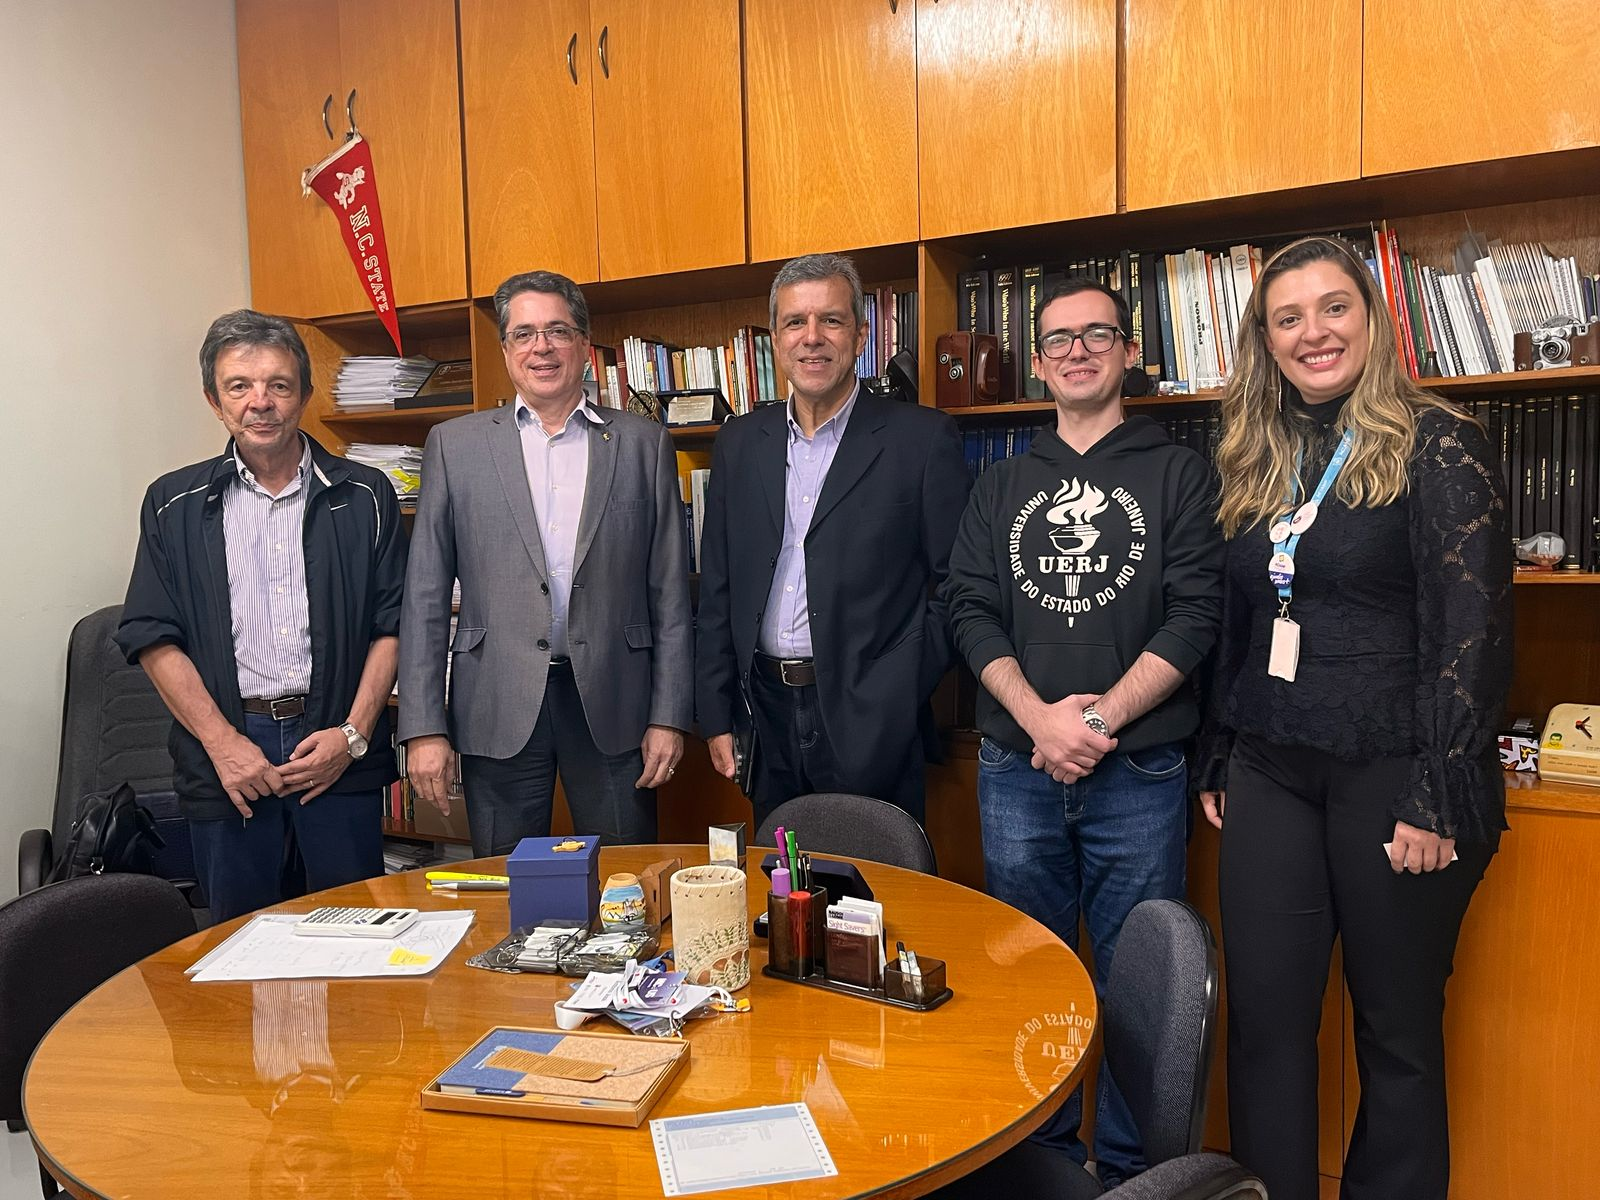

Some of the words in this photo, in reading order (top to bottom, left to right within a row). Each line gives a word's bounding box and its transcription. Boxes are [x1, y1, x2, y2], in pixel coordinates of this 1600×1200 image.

[1002, 341, 1010, 364] World
[1110, 486, 1147, 536] JANEIRO
[1009, 490, 1049, 580] UNIVERSIDADE
[1128, 541, 1146, 561] DE
[1038, 555, 1110, 573] UERJ
[1114, 564, 1136, 589] RIO
[1020, 579, 1040, 599] DO
[1095, 586, 1116, 607] DO
[1041, 594, 1091, 613] ESTADO
[829, 920, 843, 929] Sight
